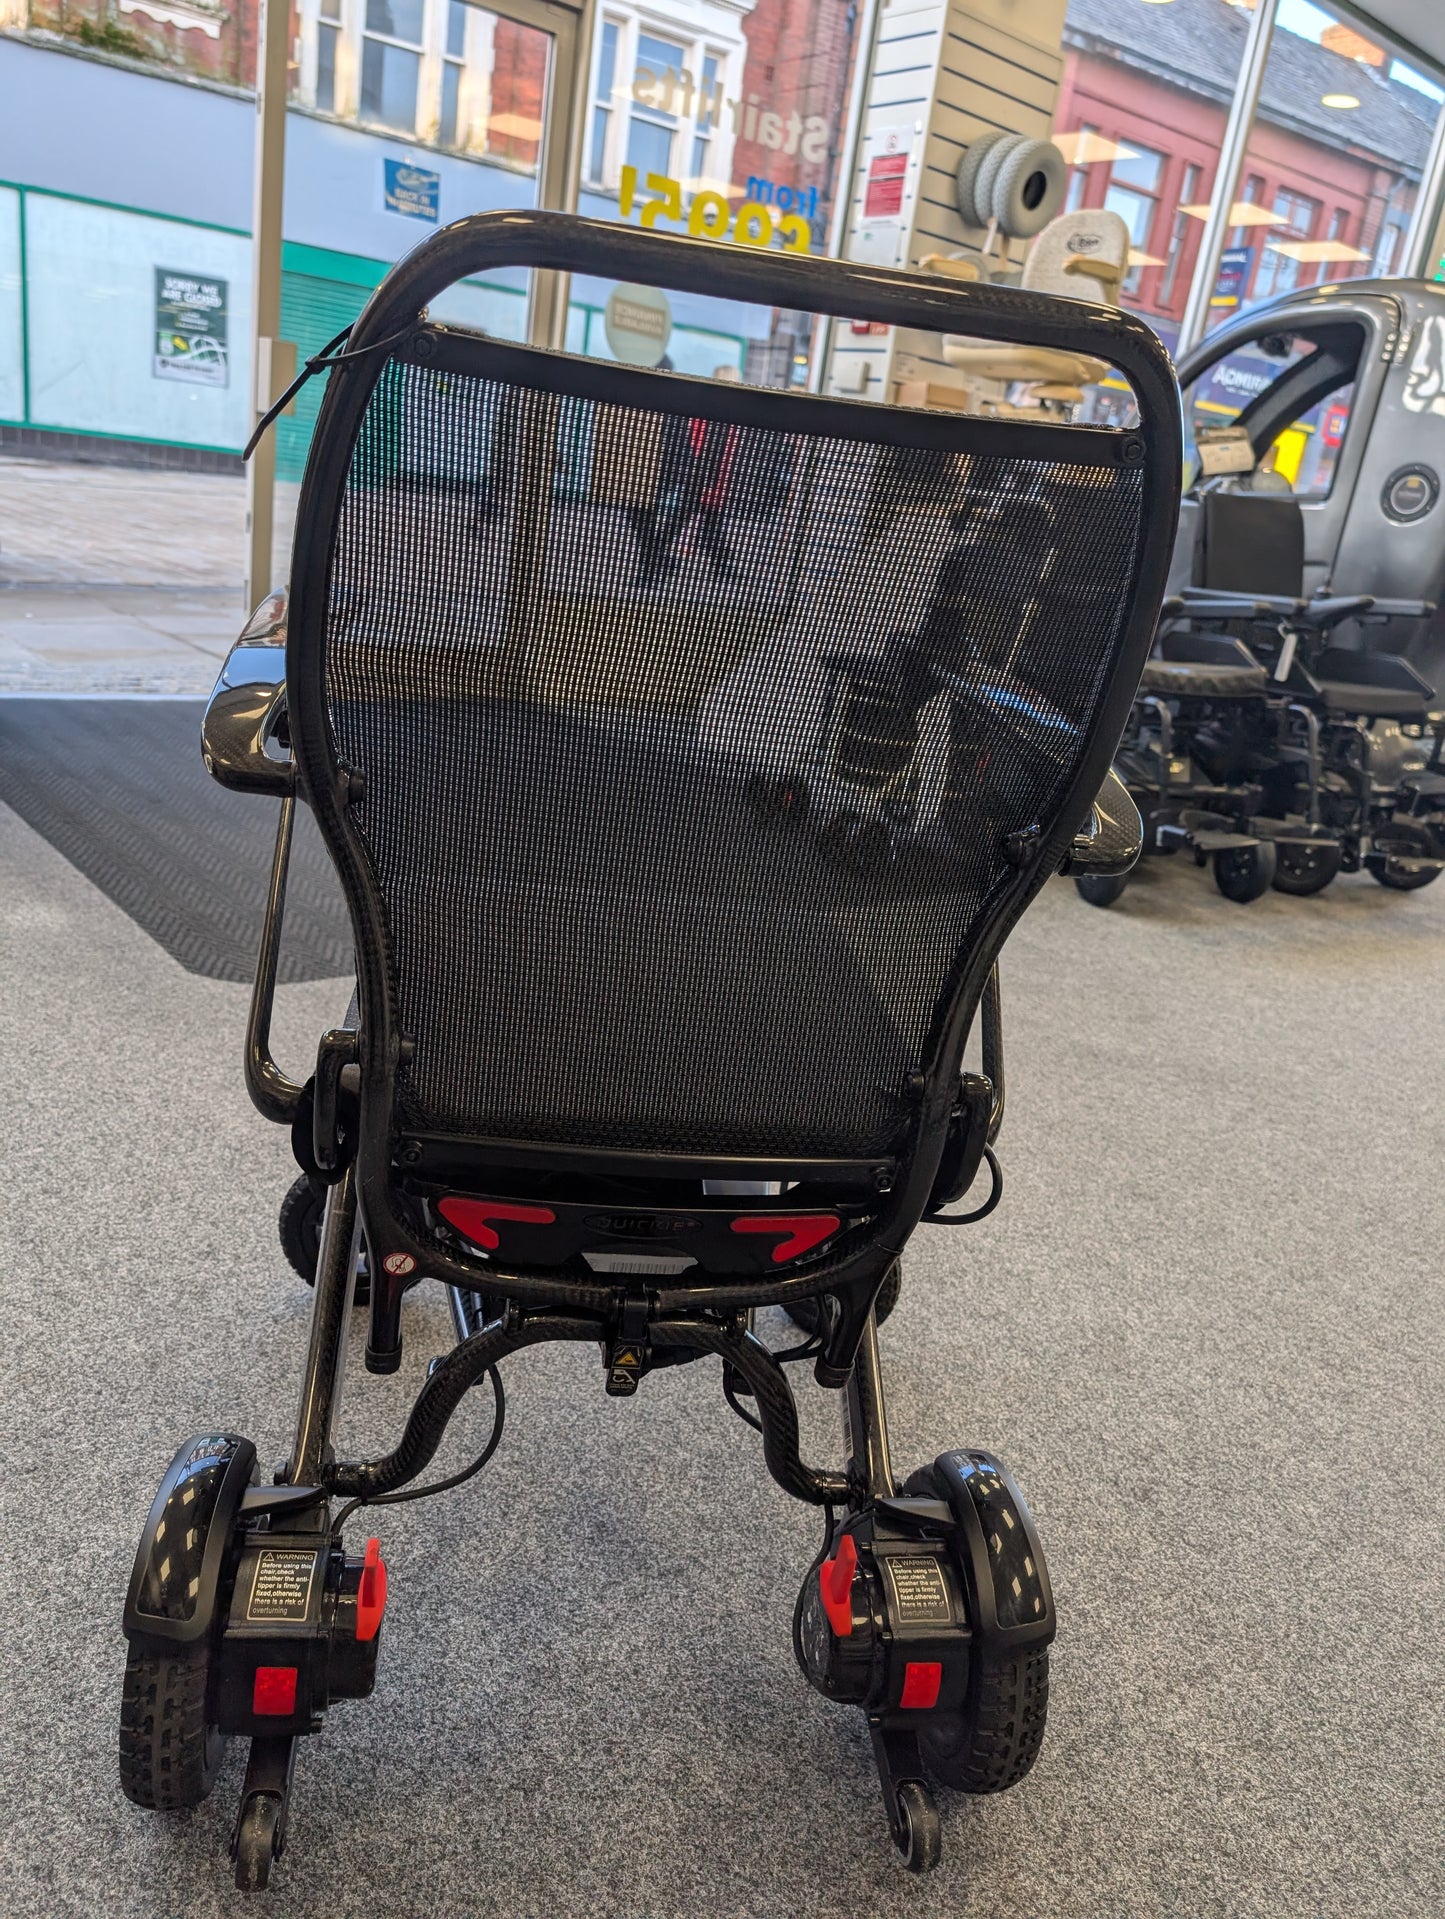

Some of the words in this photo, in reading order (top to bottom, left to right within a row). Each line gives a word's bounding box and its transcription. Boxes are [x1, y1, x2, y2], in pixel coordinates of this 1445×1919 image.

[164, 276, 198, 294] SORRY
[161, 289, 181, 301] ARE
[276, 1553, 314, 1561] WARNING
[257, 1582, 276, 1590] tipper
[283, 1582, 301, 1591] firmly
[921, 1586, 936, 1594] firmly
[297, 1598, 305, 1606] of
[938, 1600, 945, 1608] of
[252, 1606, 288, 1616] overturning
[902, 1610, 934, 1618] overturning
